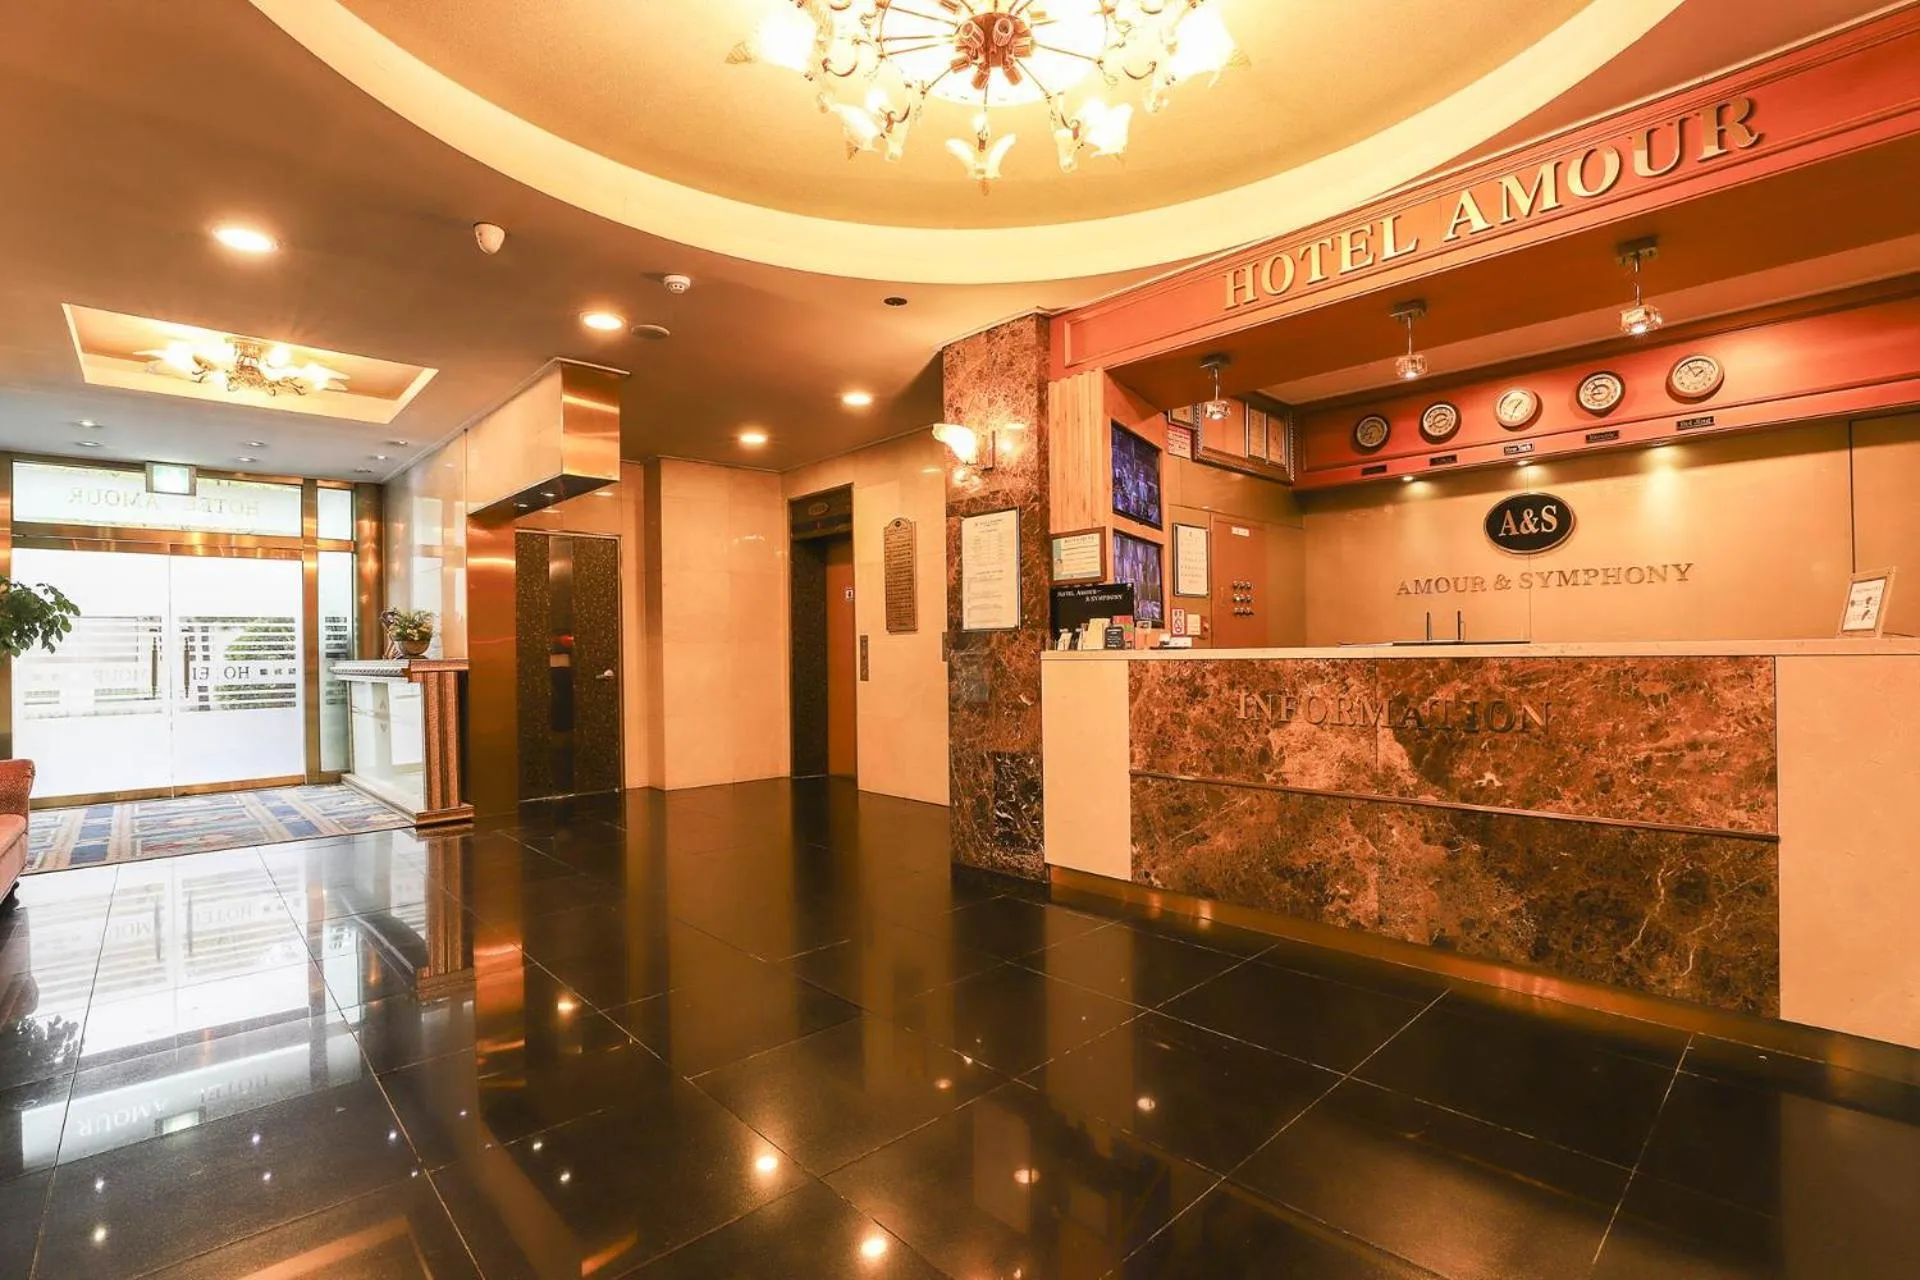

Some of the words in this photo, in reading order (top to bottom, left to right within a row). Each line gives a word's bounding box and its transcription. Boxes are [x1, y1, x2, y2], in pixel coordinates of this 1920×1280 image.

[1223, 214, 1419, 309] HOTEL
[1442, 96, 1763, 243] AMOUR
[1499, 505, 1558, 536] A&S
[1397, 572, 1488, 597] AMOUR
[1492, 571, 1512, 592] &
[1518, 562, 1695, 590] SYMPHONY
[1237, 691, 1551, 736] INFORMATION
